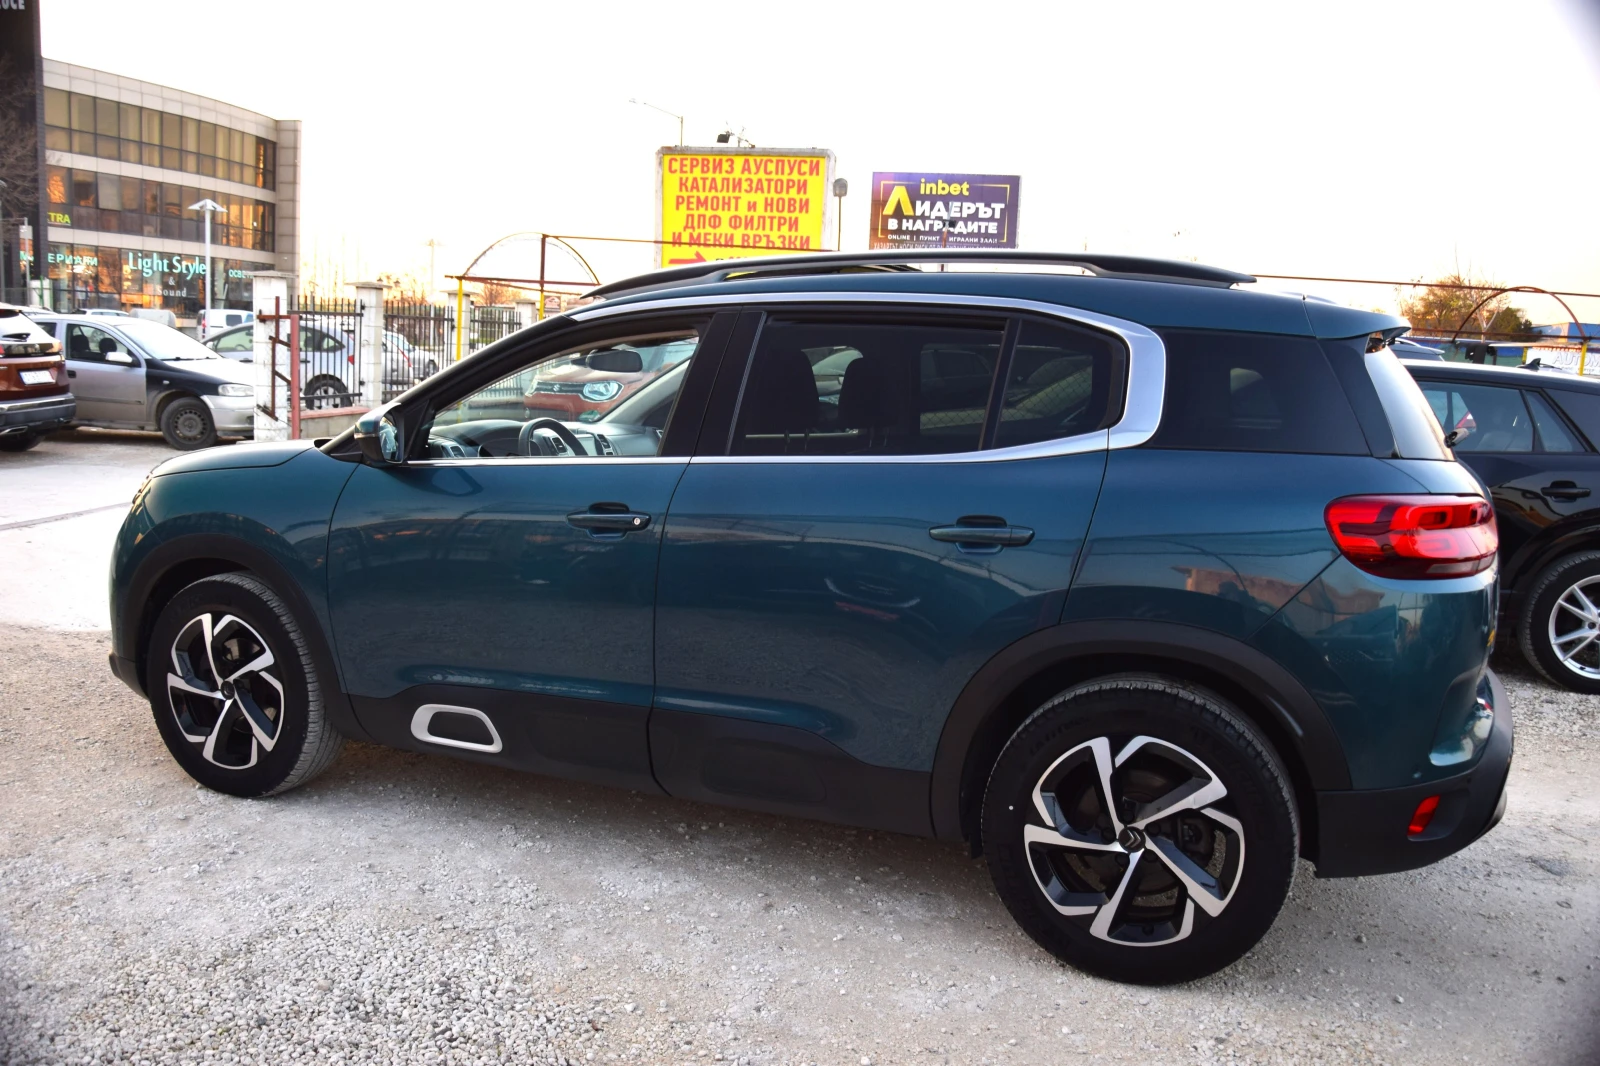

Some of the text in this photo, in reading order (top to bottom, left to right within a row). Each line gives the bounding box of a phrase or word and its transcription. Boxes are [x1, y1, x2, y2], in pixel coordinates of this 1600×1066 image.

[668, 157, 820, 177] СЕРВИЗ АУСПУСИ
[679, 176, 808, 195] КАТАЛИЗАТОРИ
[919, 178, 970, 196] inbet
[675, 195, 809, 214] РЕМОНТ и НОВИ
[882, 185, 1005, 219] ЛИДЕРЪТ
[683, 213, 799, 232] ДПФ ФИЛТРИ
[887, 218, 899, 231] В
[672, 232, 810, 250] И МЕКИ ВРЪЗКИ
[128, 252, 207, 280] Light Style
[157, 285, 187, 298] Sound
